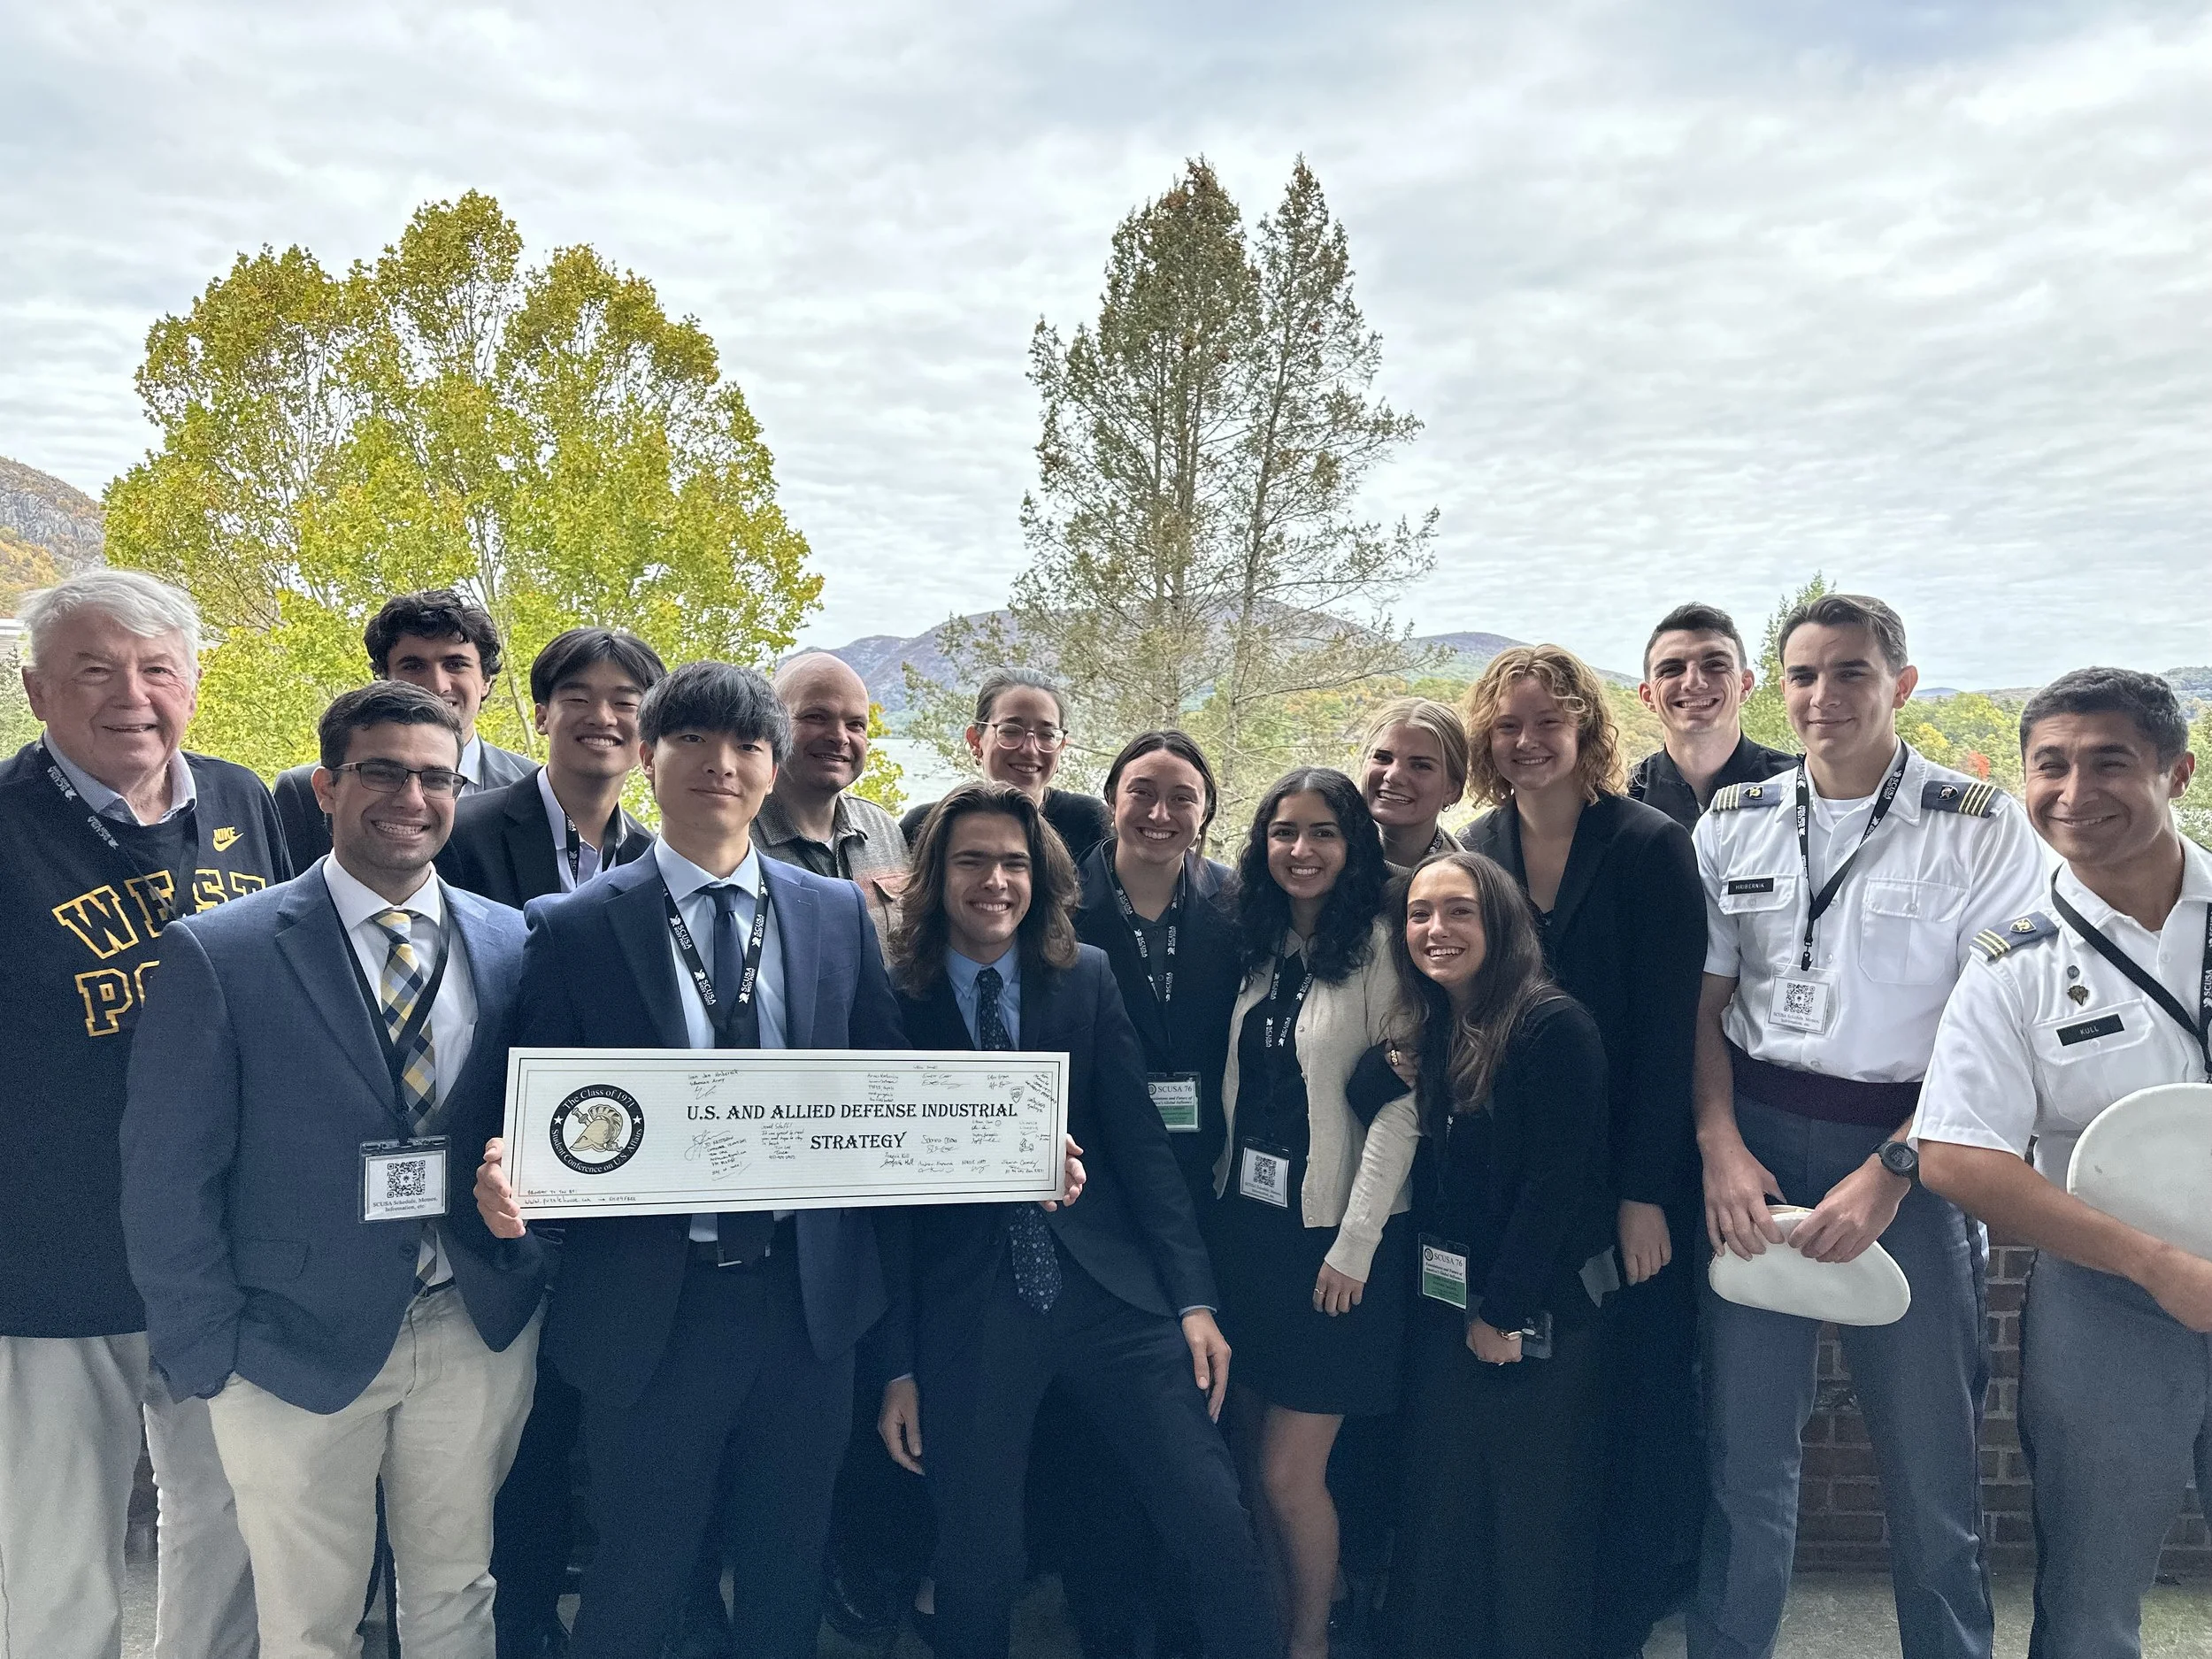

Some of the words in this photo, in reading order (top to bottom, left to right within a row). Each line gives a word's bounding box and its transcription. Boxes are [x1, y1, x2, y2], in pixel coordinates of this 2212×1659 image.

[1885, 778, 1899, 800] SCUSA
[213, 826, 234, 841] NIKE
[52, 869, 266, 959] WES
[678, 924, 693, 949] SCUSA
[754, 914, 763, 937] SCUSA
[741, 967, 752, 992] SCUSA
[702, 979, 717, 1005] SCUSA
[2079, 1025, 2099, 1035] KULL
[562, 1096, 580, 1110] The
[580, 1089, 604, 1098] Class
[617, 1091, 635, 1109] 1971
[687, 1105, 720, 1121] U.S.
[726, 1105, 765, 1120] AND
[770, 1104, 835, 1119] ALLIED
[840, 1103, 918, 1119] DEFENSE
[921, 1103, 1018, 1118] INDUSTRIAL
[551, 1129, 566, 1156] Student
[564, 1154, 603, 1173] Conference
[613, 1154, 630, 1166] U.S.
[627, 1128, 643, 1154] Affairs
[810, 1131, 908, 1149] STRATEGY
[1433, 1252, 1455, 1265] SCUSA
[1455, 1258, 1463, 1267] 76
